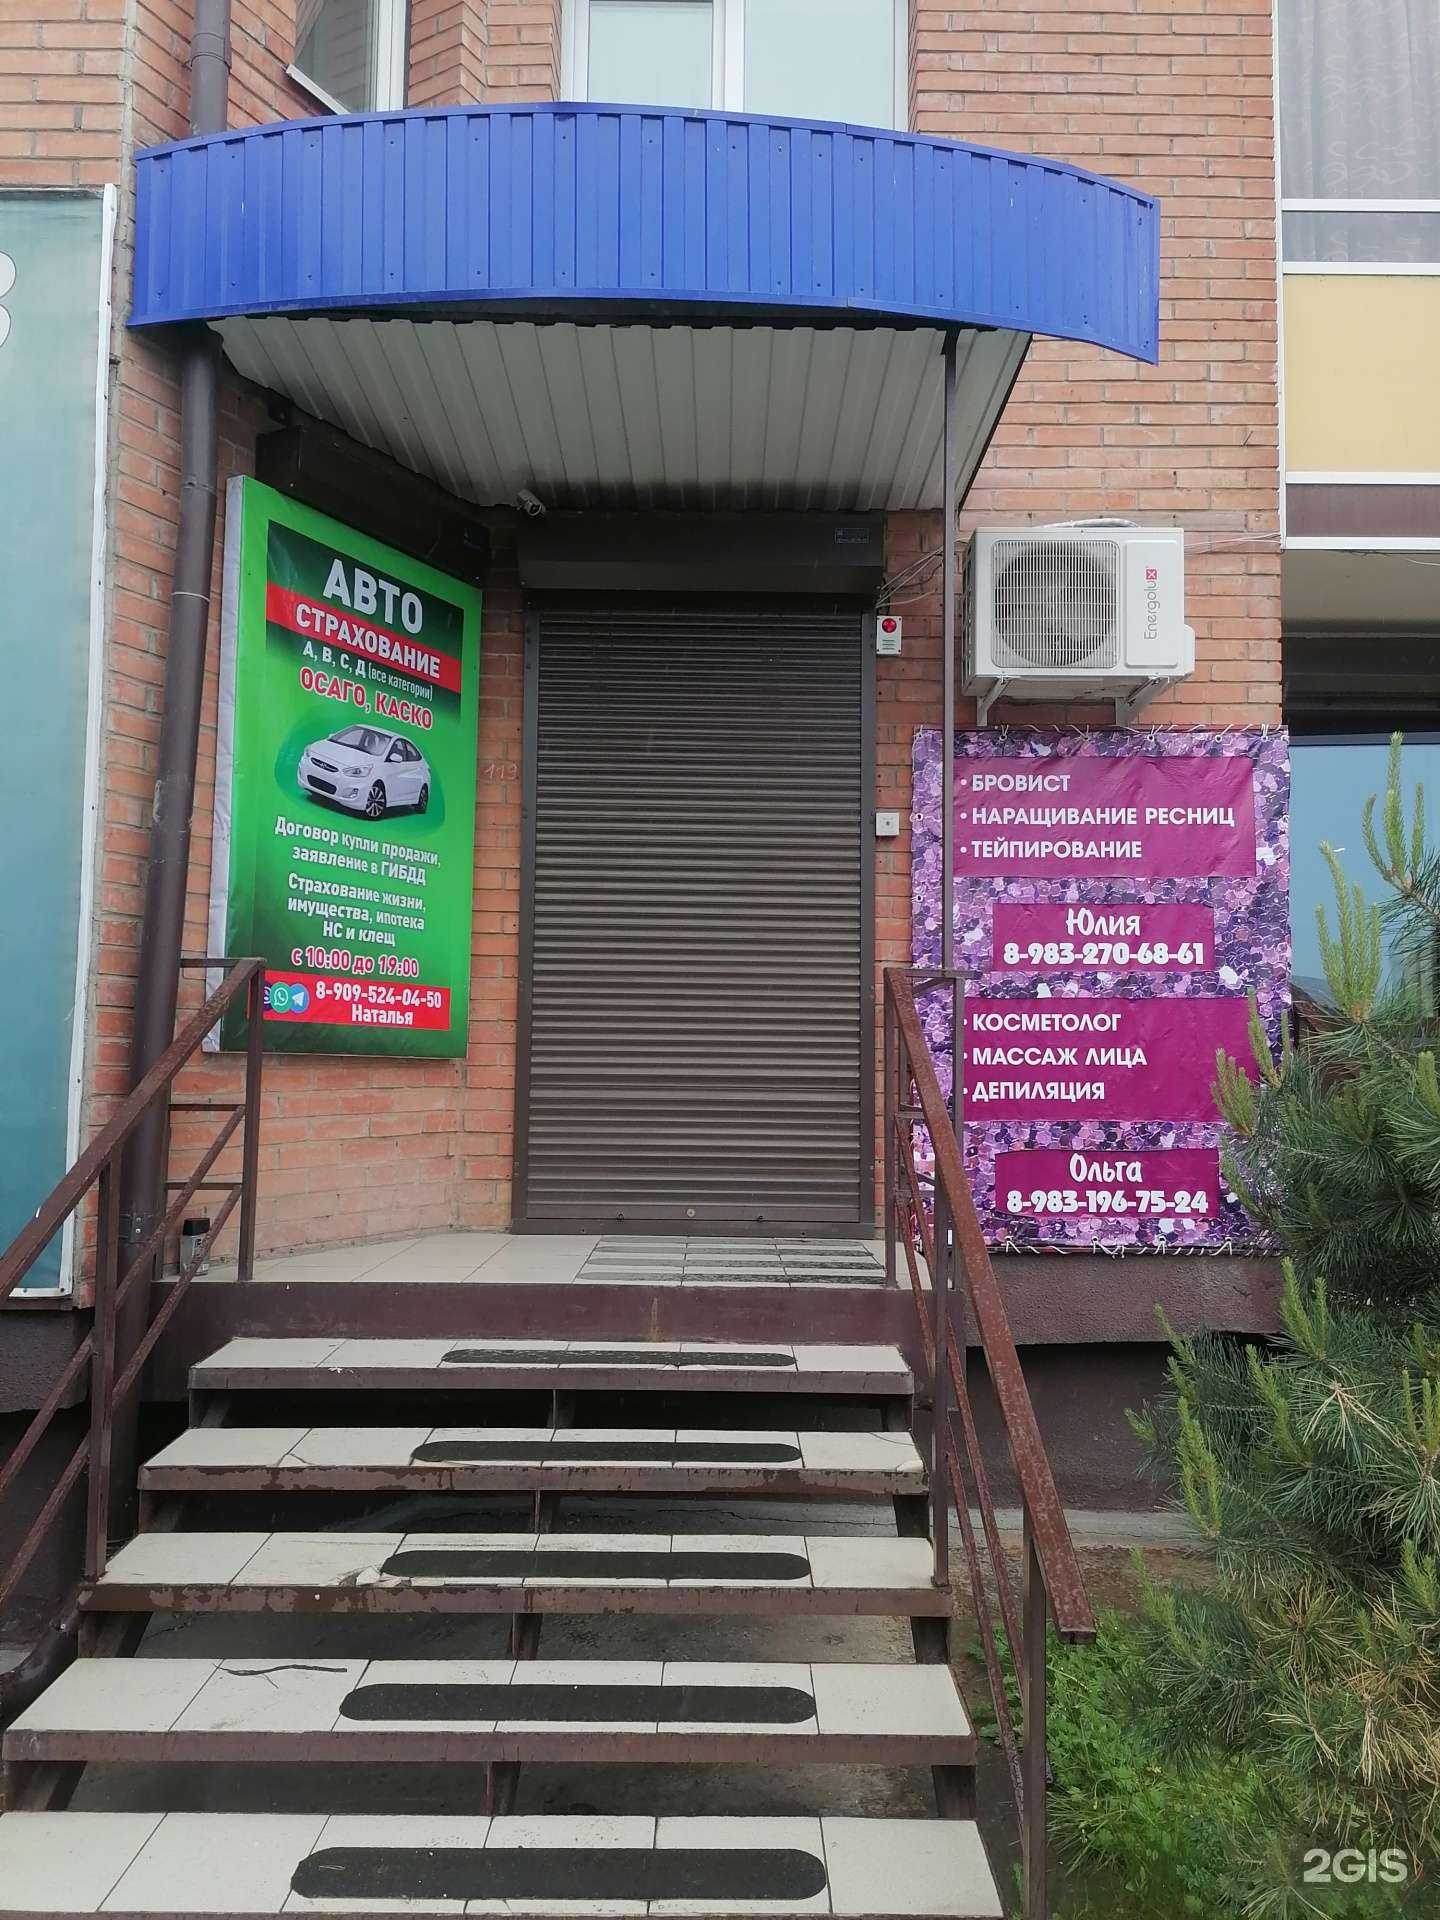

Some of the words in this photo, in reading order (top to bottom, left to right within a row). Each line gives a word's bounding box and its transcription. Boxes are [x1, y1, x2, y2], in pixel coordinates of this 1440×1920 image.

[323, 559, 422, 633] АВТО
[296, 603, 440, 679] СТРАХОВАНИЕ
[303, 641, 318, 661] А,
[322, 646, 336, 667] В,
[340, 653, 352, 673] С,
[355, 659, 366, 678] Д
[368, 662, 386, 683] (все
[388, 674, 433, 701] категории)
[300, 667, 371, 713] ОСАГО,
[375, 691, 432, 730] КАСКО
[972, 774, 1071, 792] БРОВИСТ
[972, 807, 1137, 828] НАРАЩИВАНИЕ
[1145, 807, 1235, 828] РЕСНИЦ
[275, 815, 339, 846] Договор
[342, 832, 379, 853] купли
[972, 837, 1142, 858] ТЕЙПИРОВАНИЕ
[292, 846, 368, 872] заявление
[371, 863, 378, 875] в
[381, 861, 426, 886] ГИБДД
[288, 872, 380, 903] Страхование
[382, 892, 426, 913] жизни,
[288, 897, 373, 924] имущества,
[376, 911, 424, 930] ипотека
[1065, 907, 1141, 936] Юлия
[323, 920, 343, 938] НС
[346, 928, 355, 940] и
[359, 928, 395, 947] клещ
[305, 946, 351, 971] 10:00
[352, 956, 374, 974] до
[378, 954, 420, 978] 19:00
[1003, 942, 1204, 965] 8-983-270-68-61
[315, 980, 442, 1008] 8-909-524-04-50
[351, 1004, 414, 1025] Наталья
[972, 1014, 1121, 1032] КОСМЕТОЛОГ
[972, 1048, 1078, 1066] МАССАЖ
[1084, 1048, 1147, 1068] ЛИЦА
[972, 1081, 1105, 1102] ДЕПИЛЯЦИЯ
[1069, 1153, 1143, 1183] Ольга
[1007, 1190, 1208, 1214] 8-983-196-75-24
